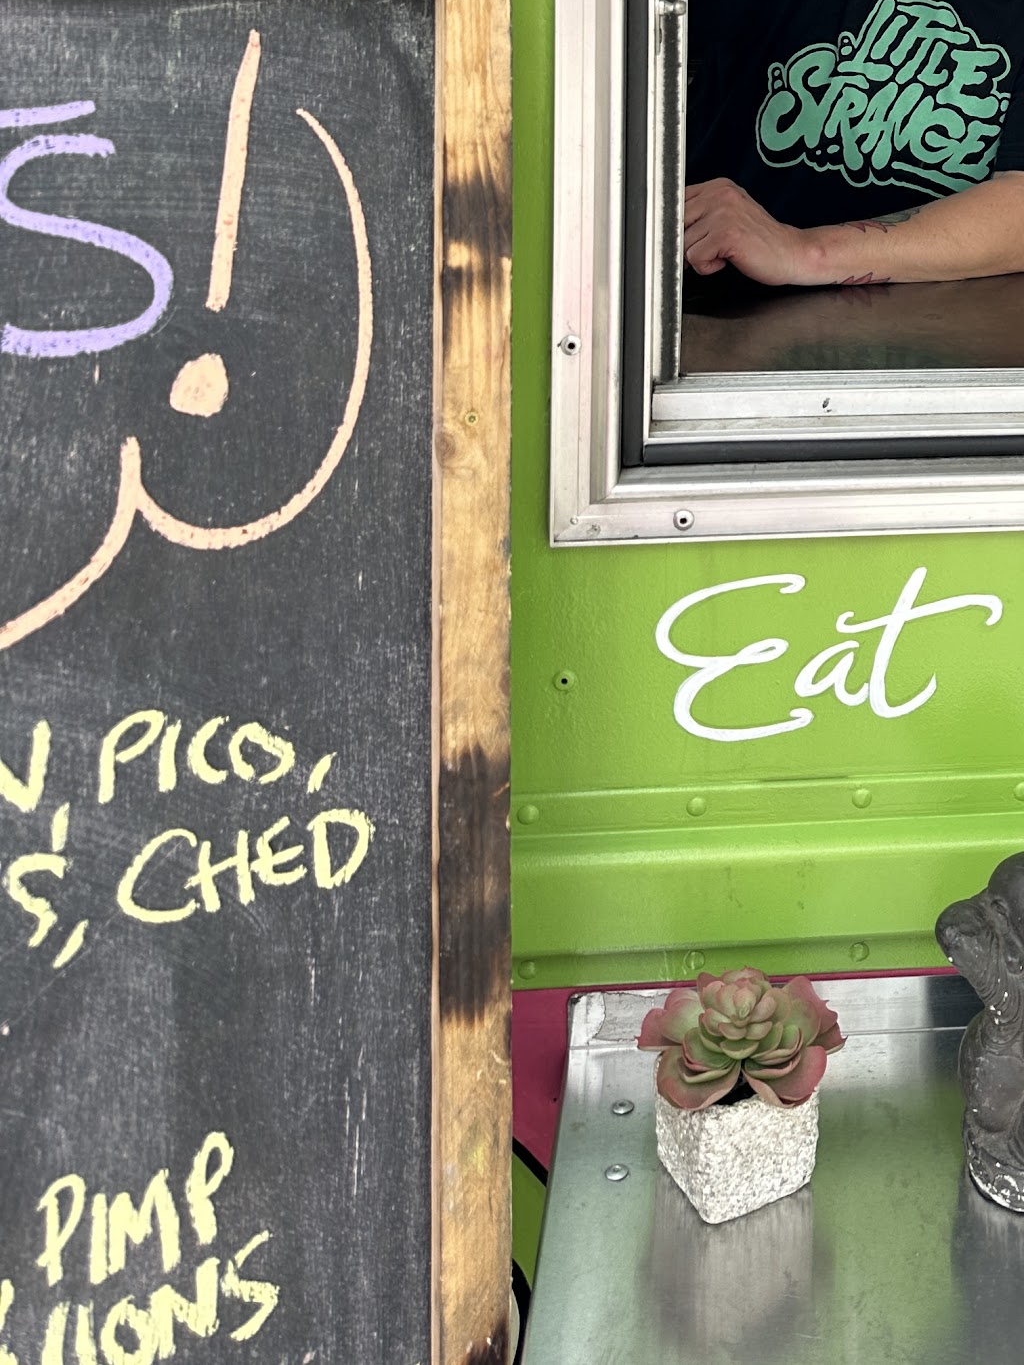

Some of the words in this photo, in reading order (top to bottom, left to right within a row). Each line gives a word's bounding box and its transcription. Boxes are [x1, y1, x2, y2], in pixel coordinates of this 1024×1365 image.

[654, 566, 1003, 742] Eat
[99, 709, 339, 803] PICO,
[117, 808, 376, 923] CHED
[37, 1131, 235, 1286] PIMP
